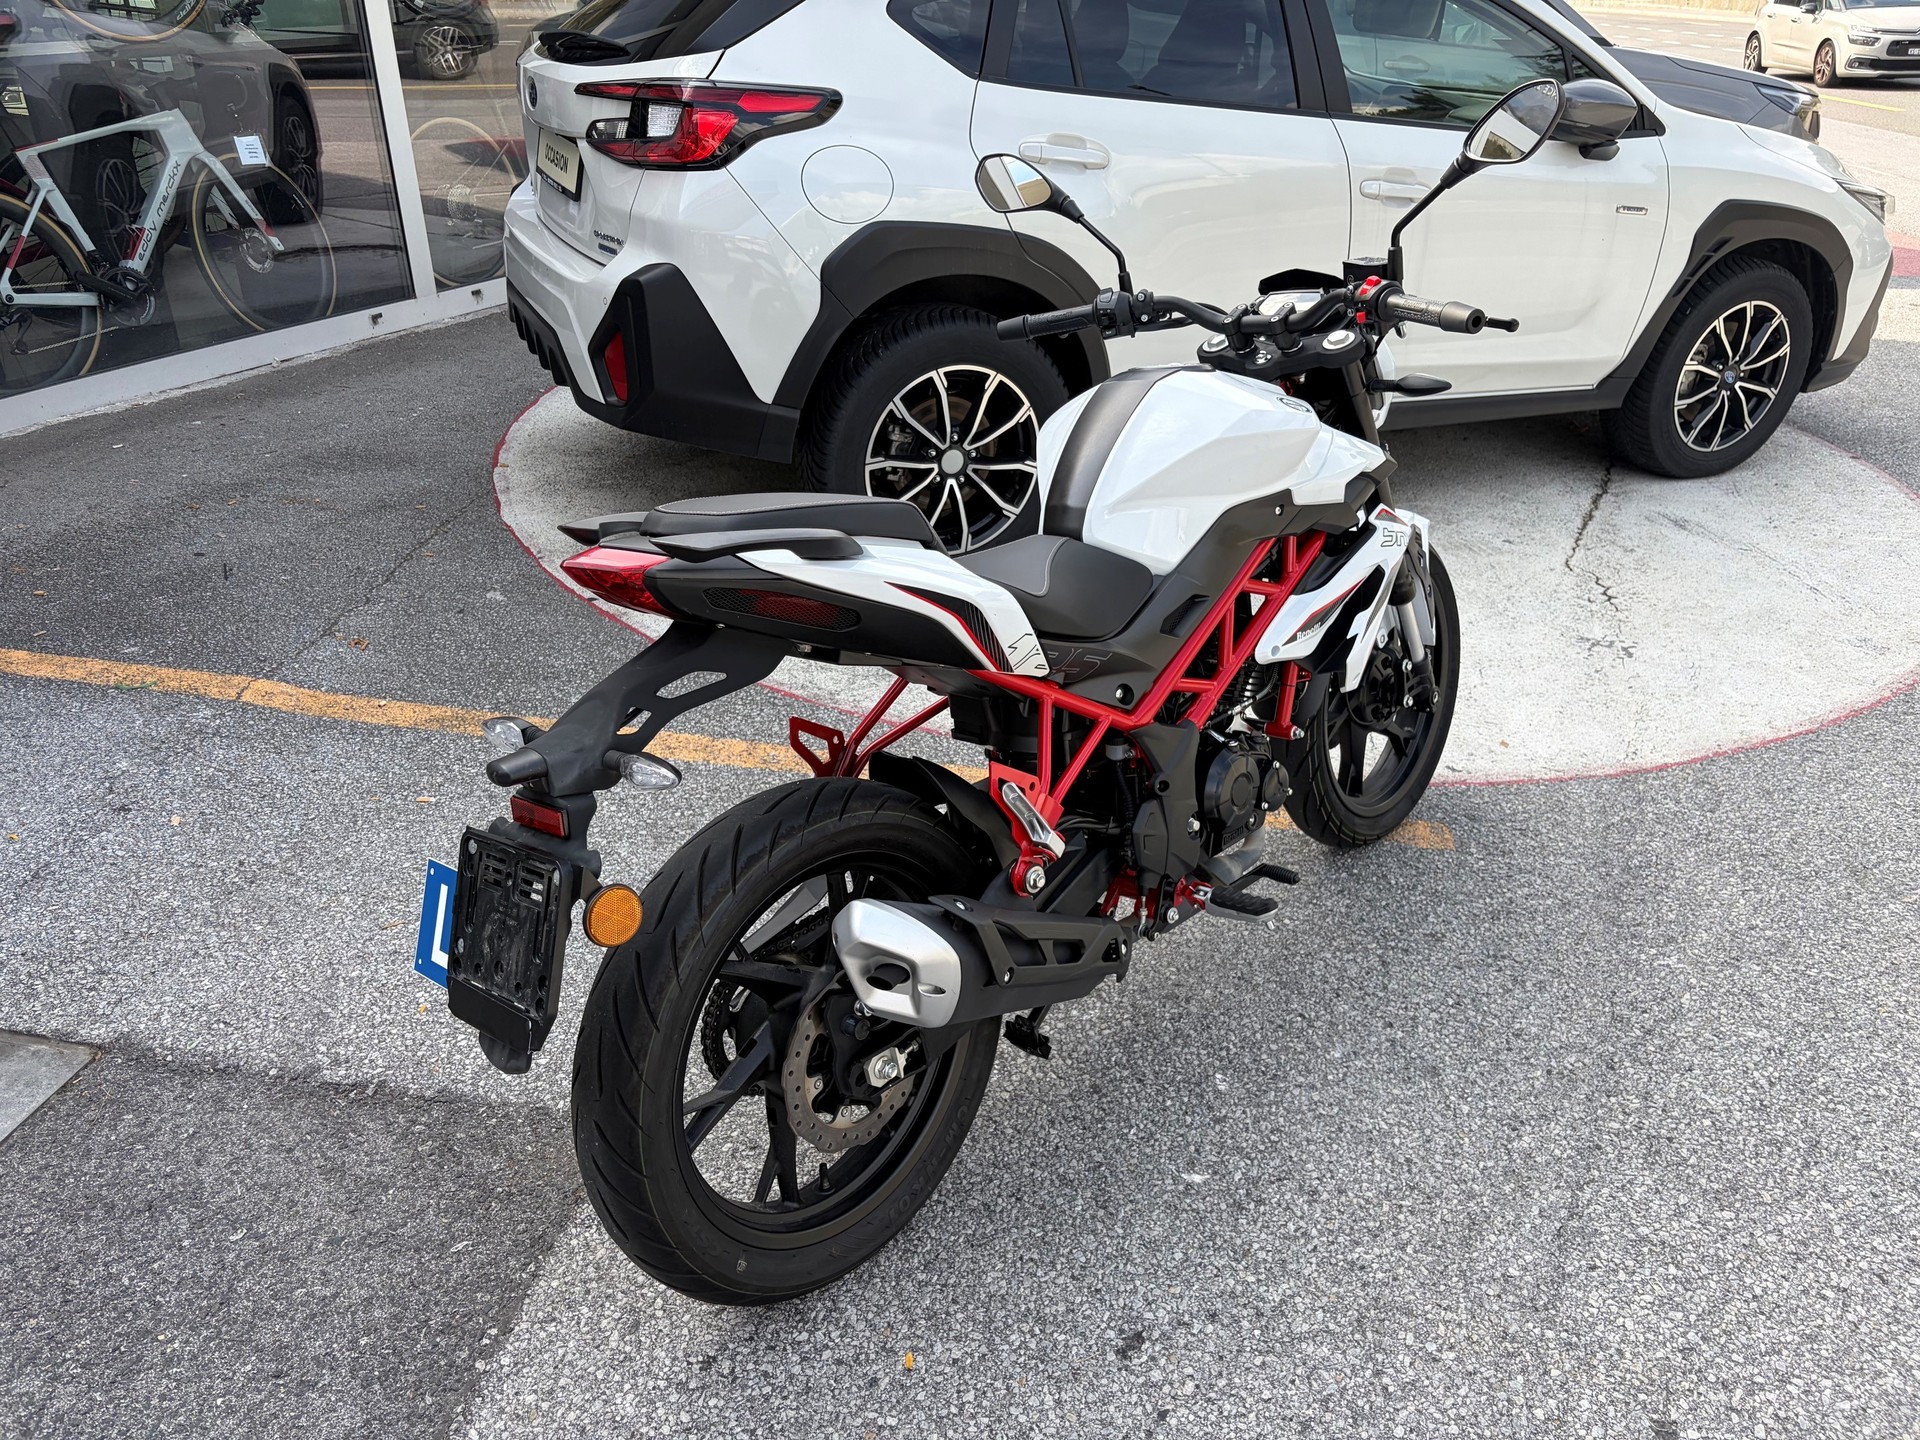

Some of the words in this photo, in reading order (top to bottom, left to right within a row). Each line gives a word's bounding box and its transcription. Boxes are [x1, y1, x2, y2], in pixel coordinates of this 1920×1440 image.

[545, 142, 569, 174] OCCASION
[138, 220, 158, 262] eddy
[156, 160, 182, 218] merckx
